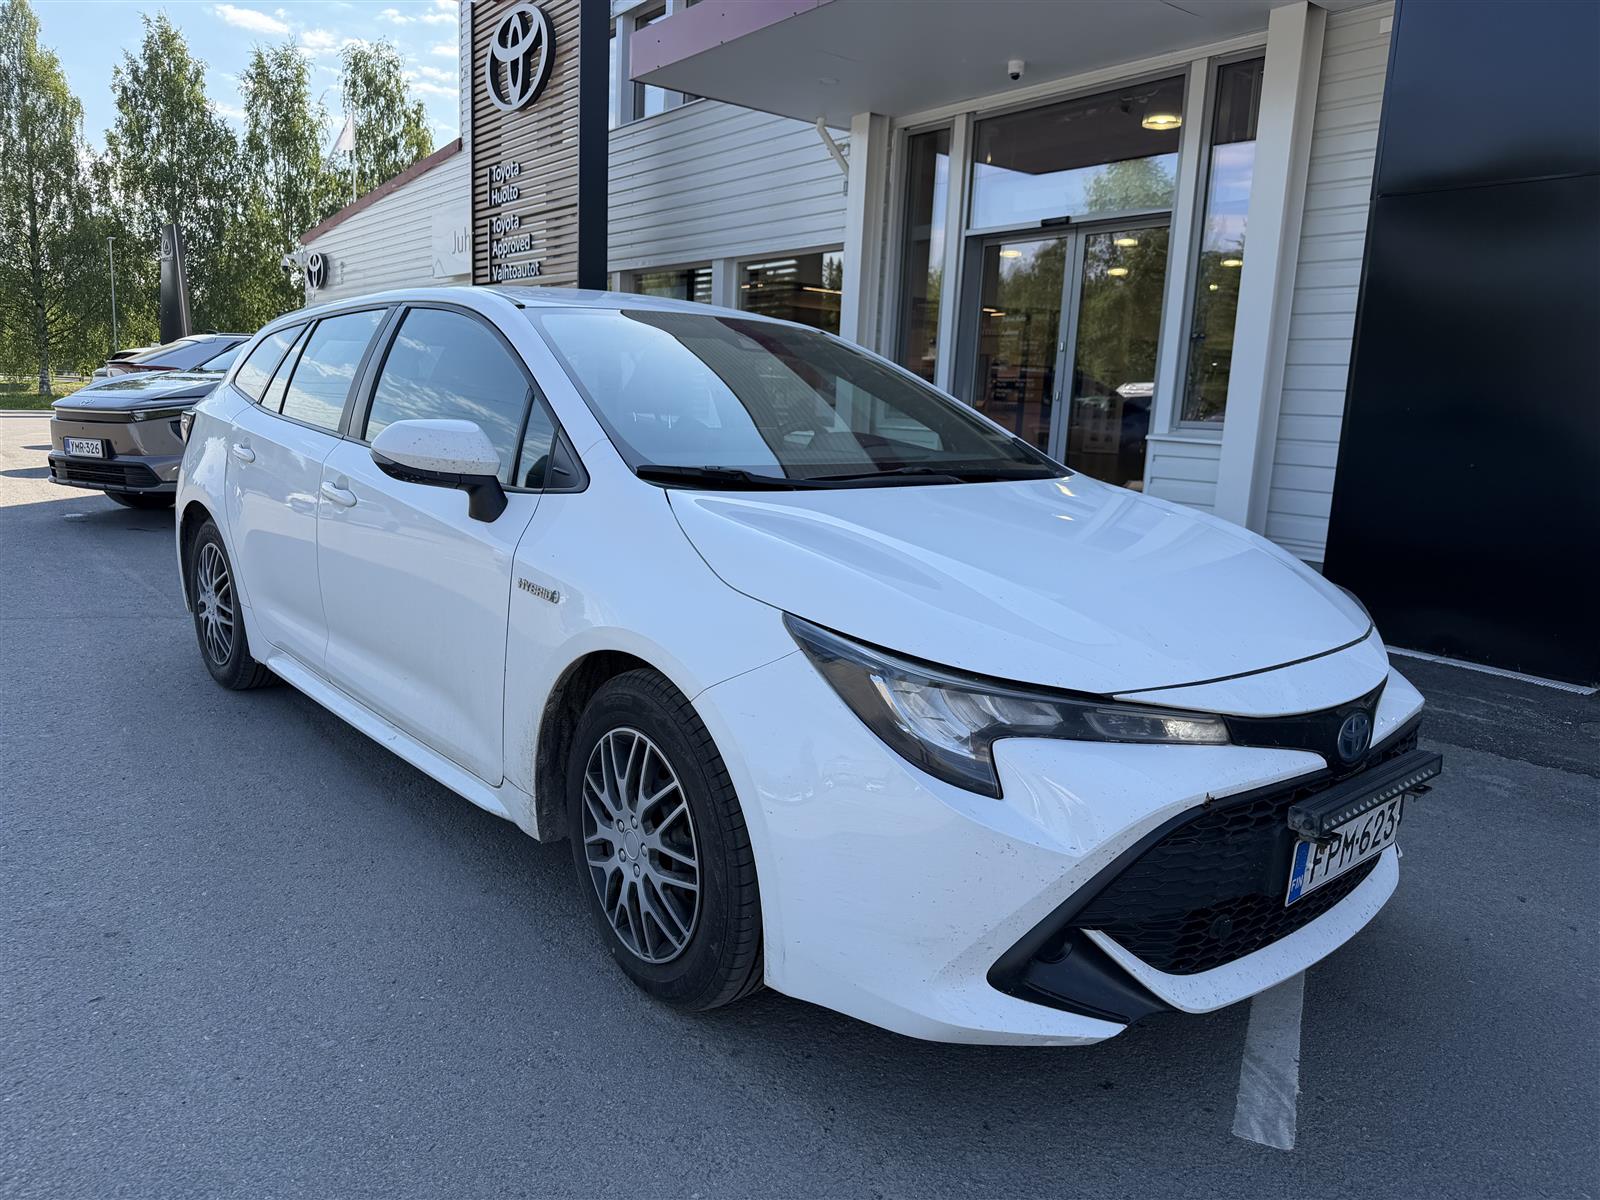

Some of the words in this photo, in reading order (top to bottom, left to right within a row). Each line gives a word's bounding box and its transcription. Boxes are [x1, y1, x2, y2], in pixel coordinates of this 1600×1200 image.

[492, 162, 519, 183] Toyota
[491, 186, 518, 205] Huolto
[492, 214, 519, 234] Toyota
[492, 234, 531, 258] Approved
[492, 261, 540, 281] Vaihtoautot
[70, 441, 100, 455] YMR-326
[517, 577, 552, 601] HYBRID
[1309, 801, 1398, 884] FPM-623
[1290, 874, 1304, 891] FIN
